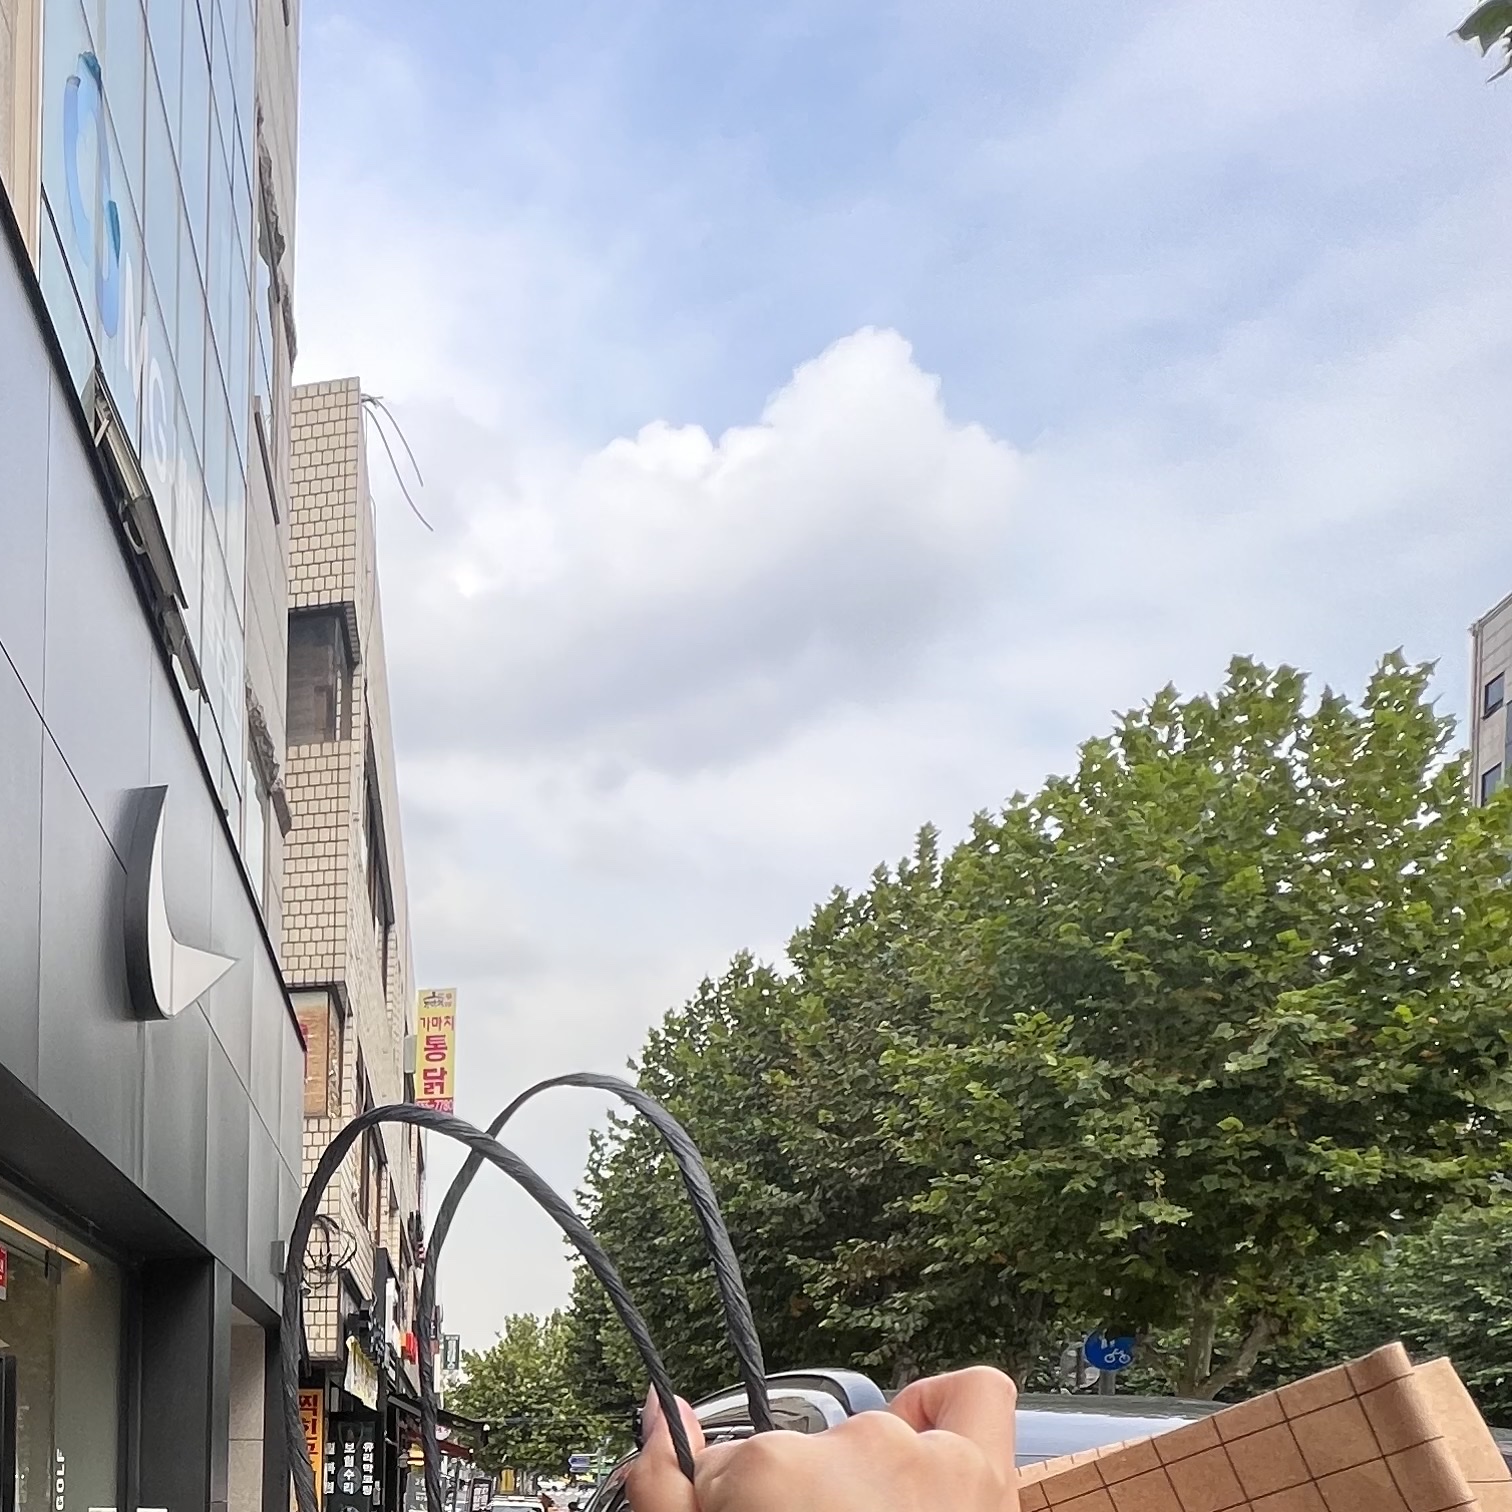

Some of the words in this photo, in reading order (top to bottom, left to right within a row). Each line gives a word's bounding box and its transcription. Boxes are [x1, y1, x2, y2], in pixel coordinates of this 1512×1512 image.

[420, 1015, 455, 1032] 가마치
[423, 1034, 448, 1094] 통닭
[56, 1448, 65, 1511] GOLF
